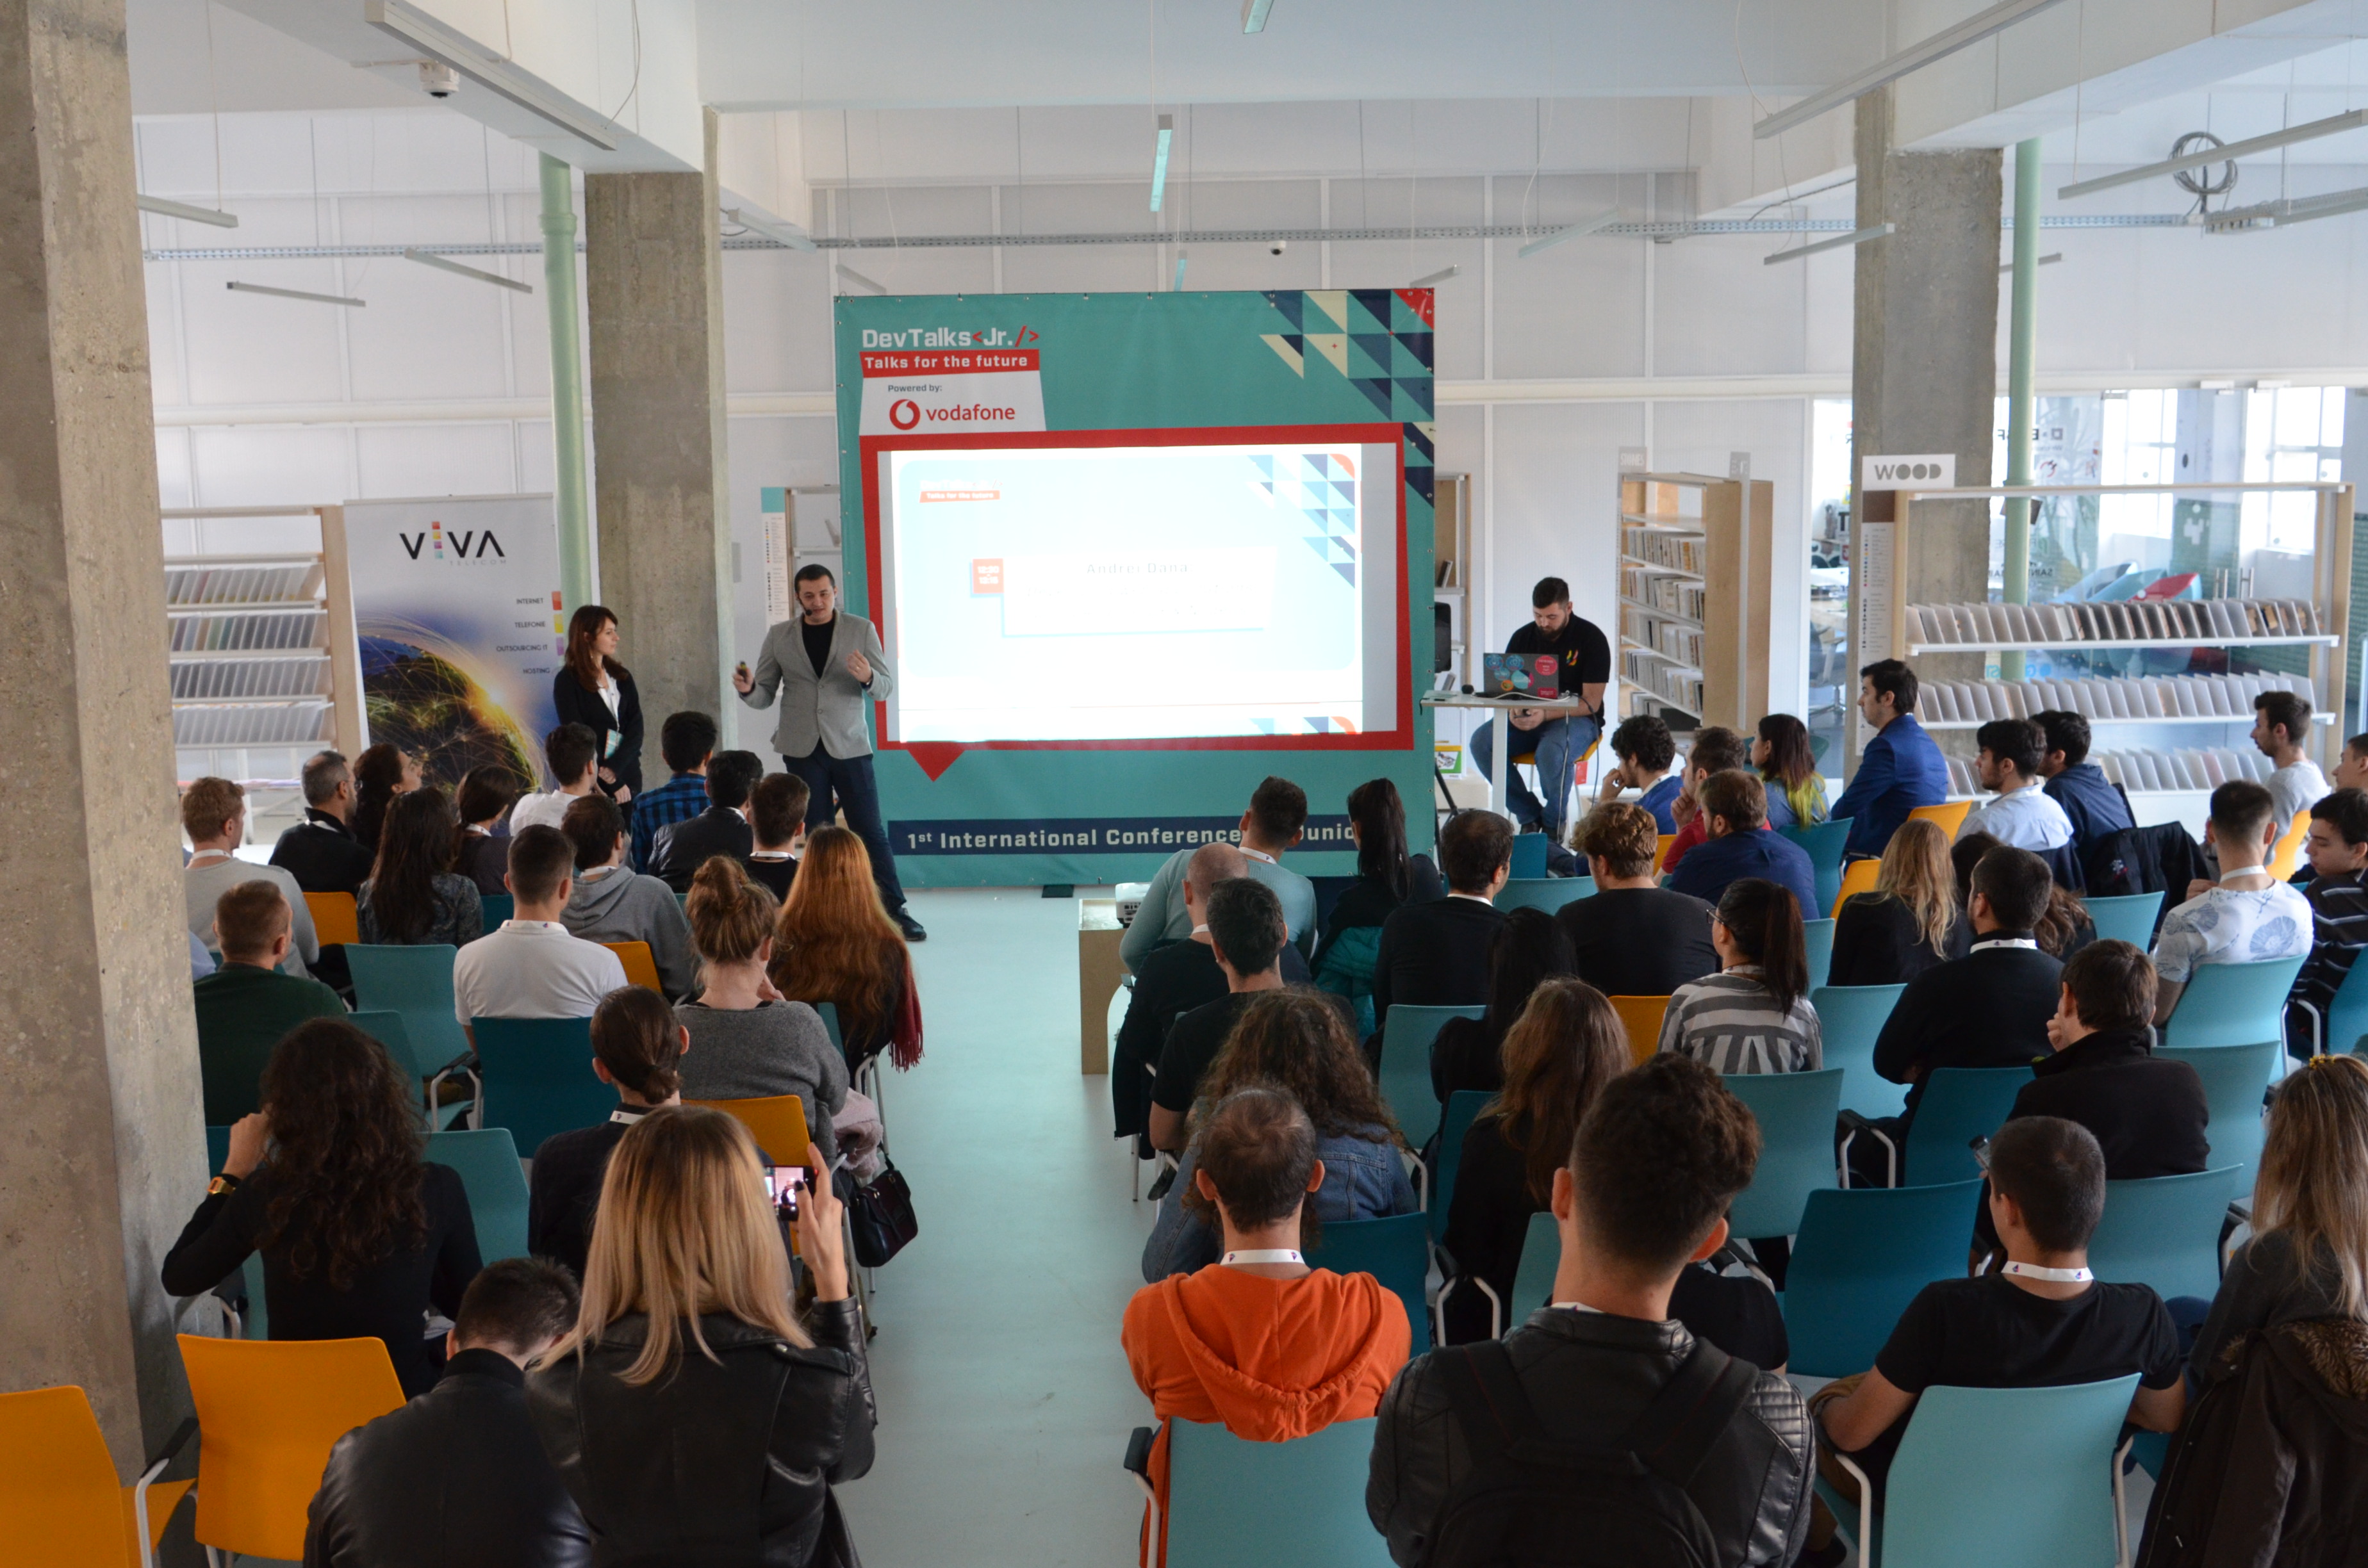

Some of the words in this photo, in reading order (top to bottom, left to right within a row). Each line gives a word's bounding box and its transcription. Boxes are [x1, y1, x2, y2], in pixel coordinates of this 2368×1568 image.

[865, 356, 909, 369] Talks
[914, 355, 937, 368] for
[943, 355, 970, 367] the
[976, 354, 1028, 367] future
[887, 384, 927, 393] Powered
[928, 384, 943, 393] by:
[925, 404, 1016, 421] vodafone
[1874, 463, 1942, 480] WOOD
[399, 521, 506, 560] VIVA
[1087, 563, 1140, 574] Andrei
[907, 833, 932, 849] 1st
[941, 829, 1097, 849] International
[1106, 828, 1242, 845] Conference
[1299, 823, 1354, 840] Junio
